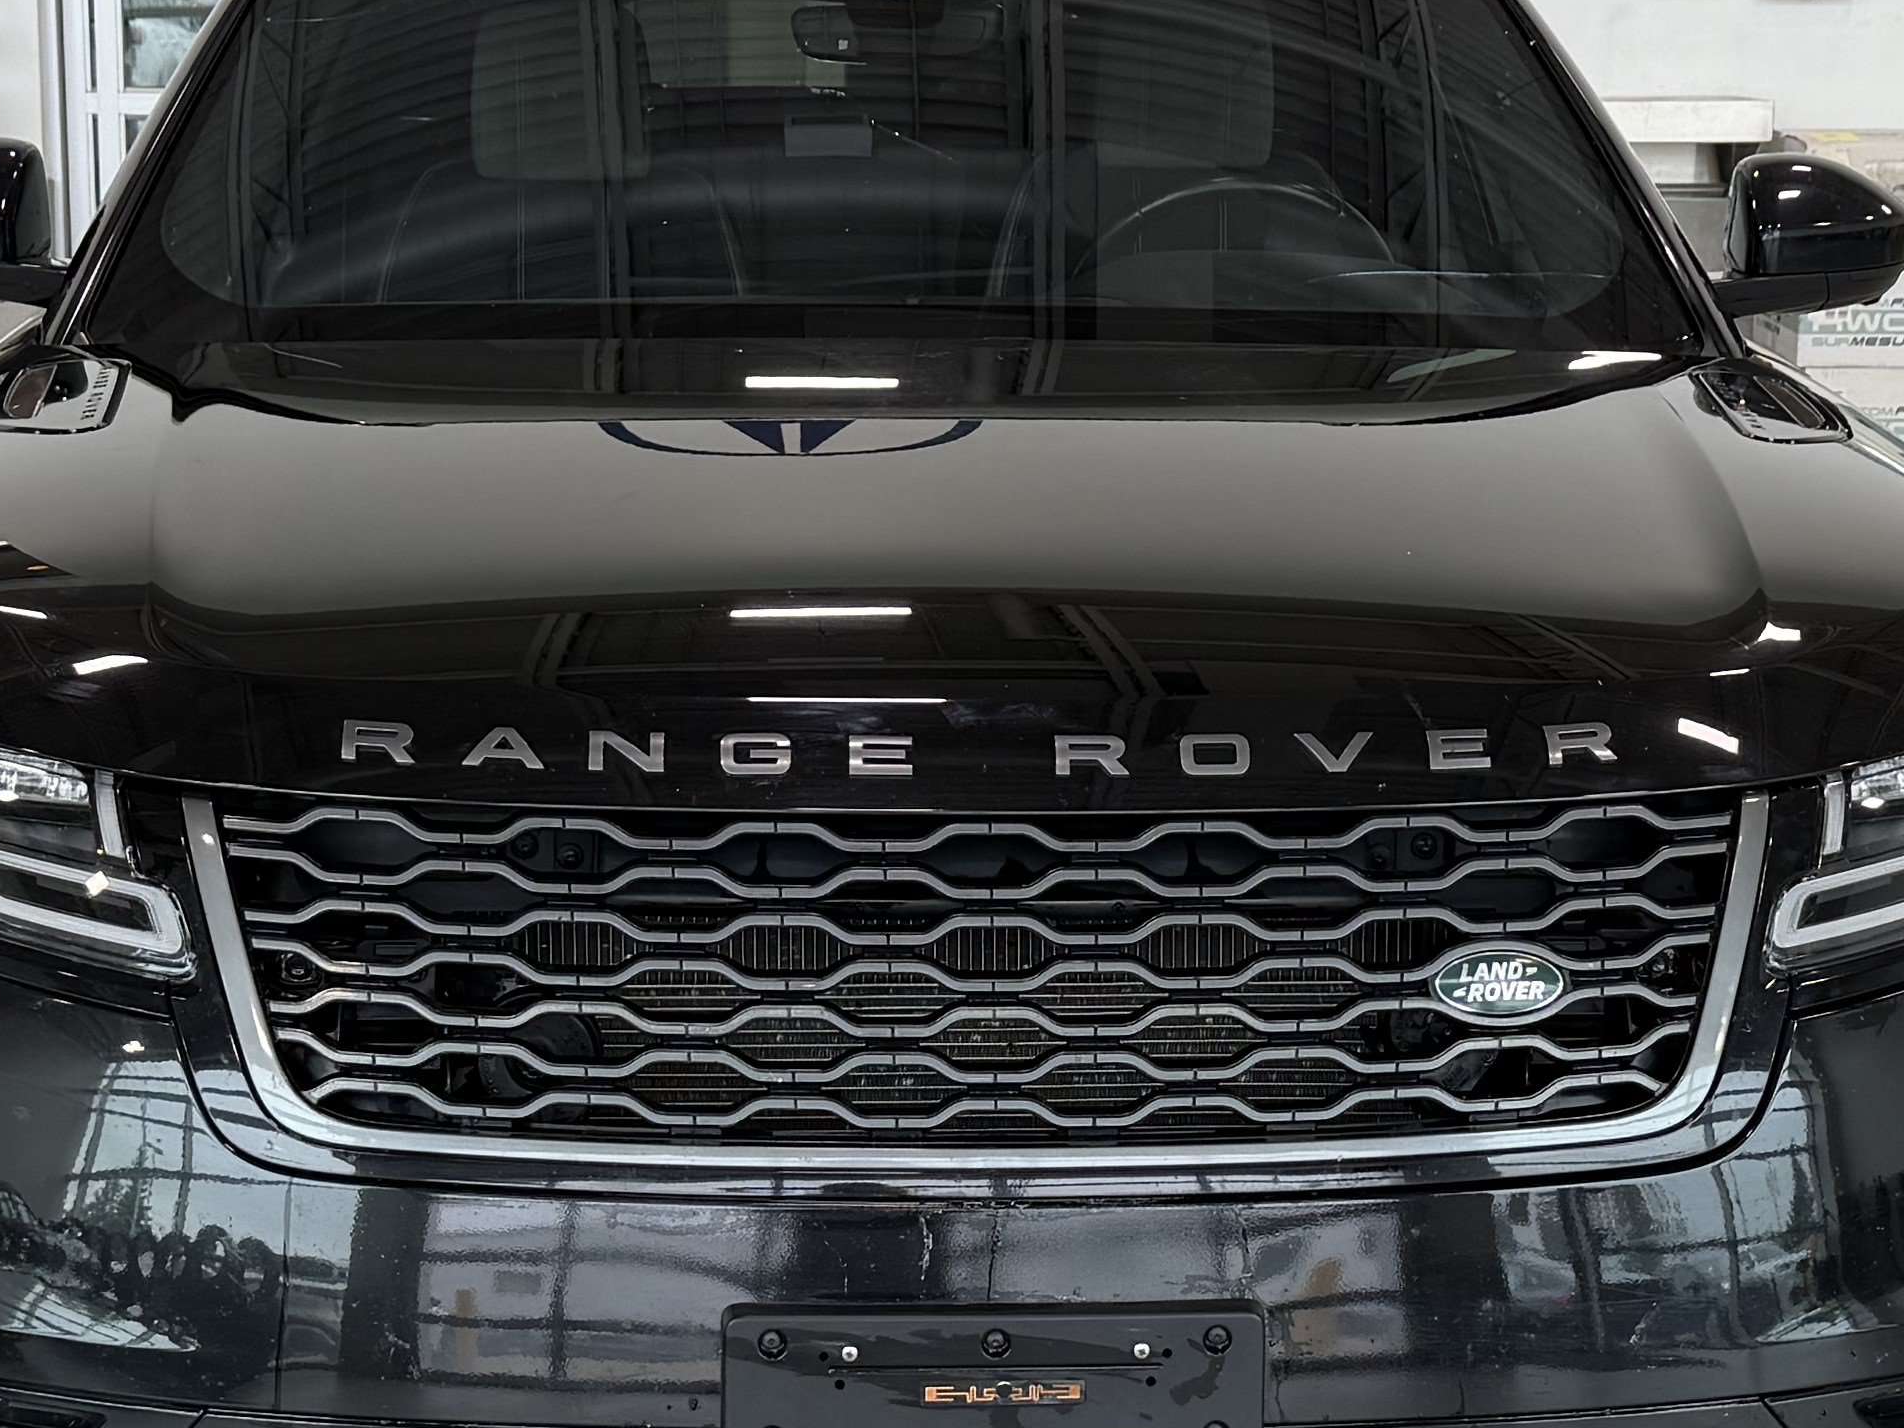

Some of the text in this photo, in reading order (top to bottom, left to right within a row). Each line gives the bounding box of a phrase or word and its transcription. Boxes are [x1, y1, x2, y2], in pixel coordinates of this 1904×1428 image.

[340, 719, 1618, 776] RANGE ROVER
[1459, 961, 1524, 983] LAND
[1467, 980, 1546, 1003] ROVER
